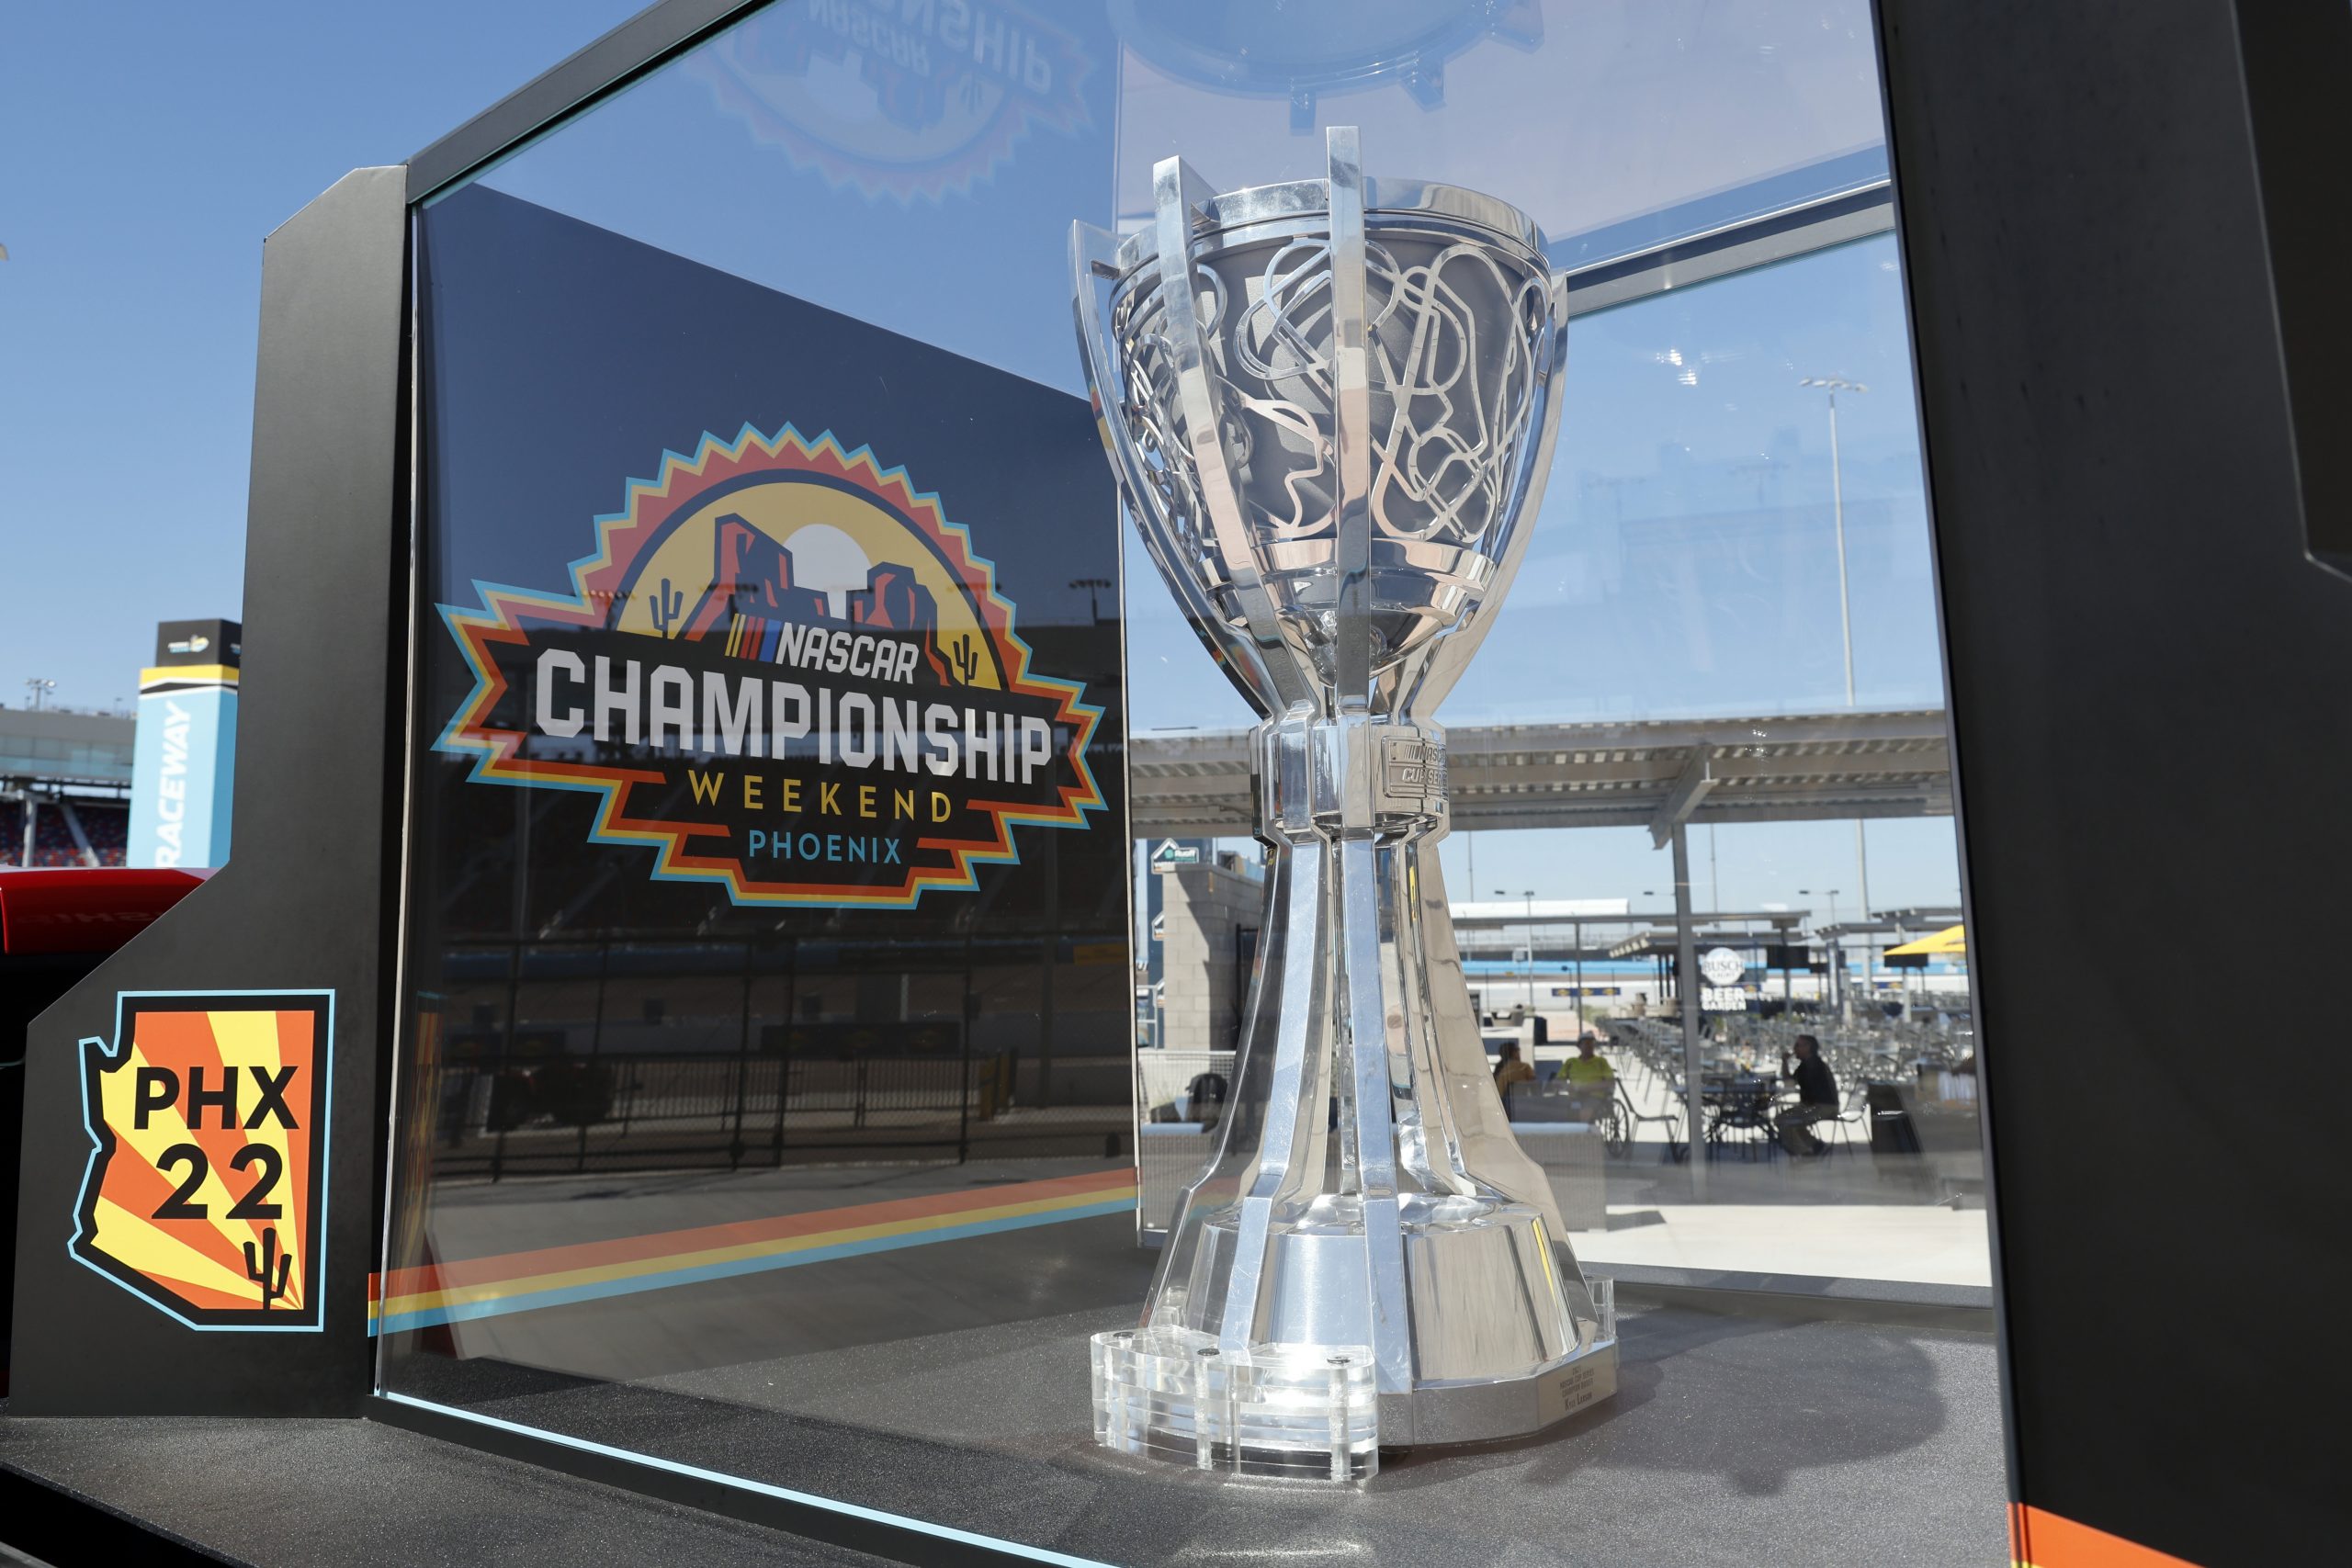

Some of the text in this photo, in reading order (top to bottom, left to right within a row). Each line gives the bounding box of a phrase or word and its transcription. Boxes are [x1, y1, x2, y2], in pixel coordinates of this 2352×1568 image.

[775, 622, 919, 683] NASCAR
[536, 648, 1051, 784] CHAMPIONSHIP
[154, 700, 191, 868] RACEWAY
[687, 769, 952, 823] WEEKEND
[1402, 767, 1425, 784] CUP
[749, 829, 902, 864] PHOENIX
[1702, 960, 1744, 972] BUSCH
[1701, 987, 1746, 1001] BEER
[1702, 1000, 1747, 1010] GARDEN
[133, 1066, 300, 1130] PHX
[151, 1143, 283, 1220] 22
